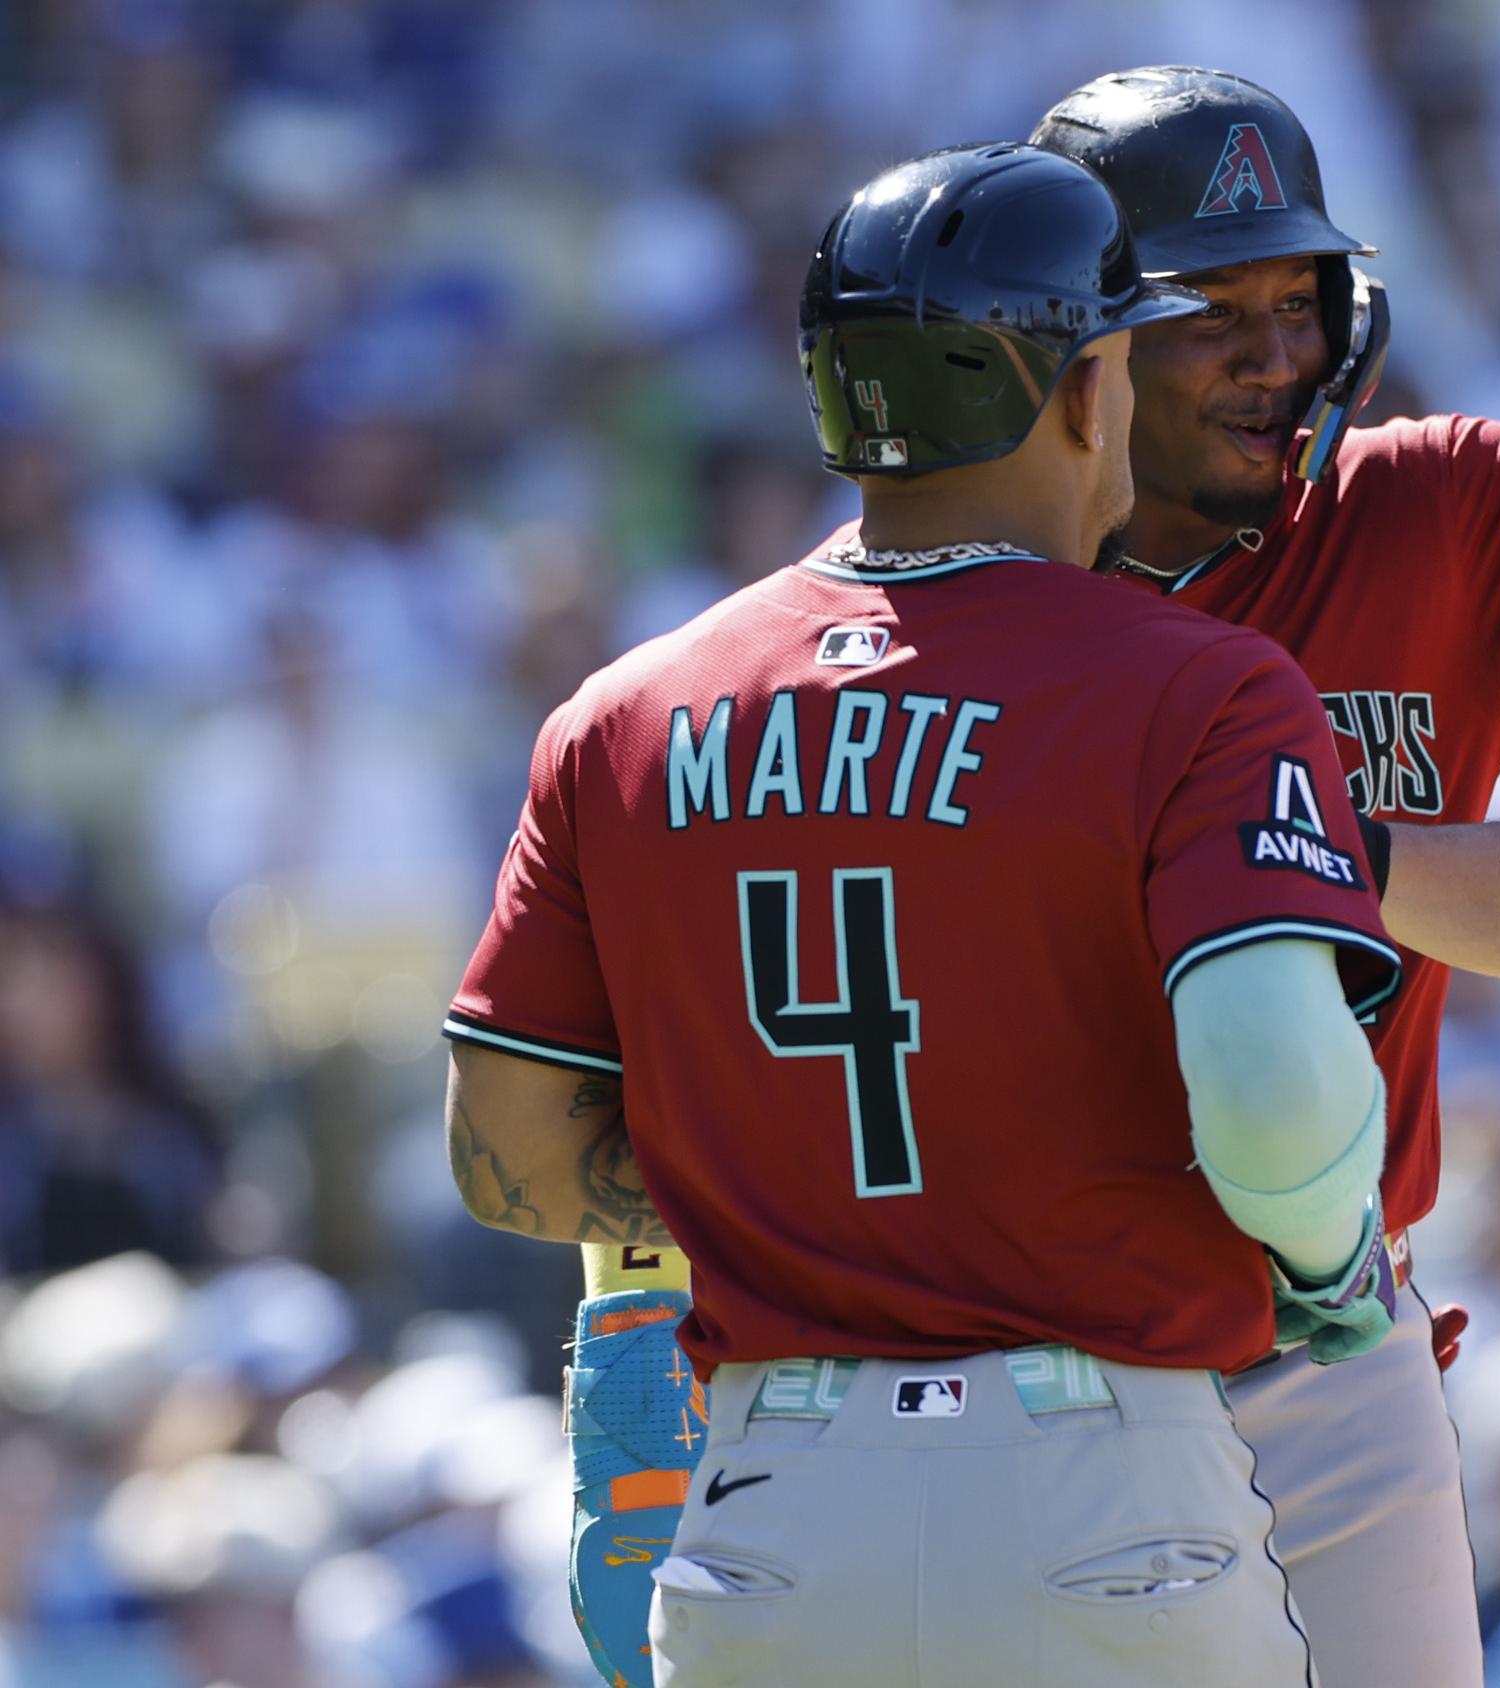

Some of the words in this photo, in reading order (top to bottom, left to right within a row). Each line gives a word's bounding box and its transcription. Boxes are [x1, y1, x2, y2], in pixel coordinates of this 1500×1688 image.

[854, 379, 889, 432] 4
[666, 688, 1003, 830] MARTE
[1254, 829, 1355, 884] AVNET
[736, 867, 923, 1199] 4
